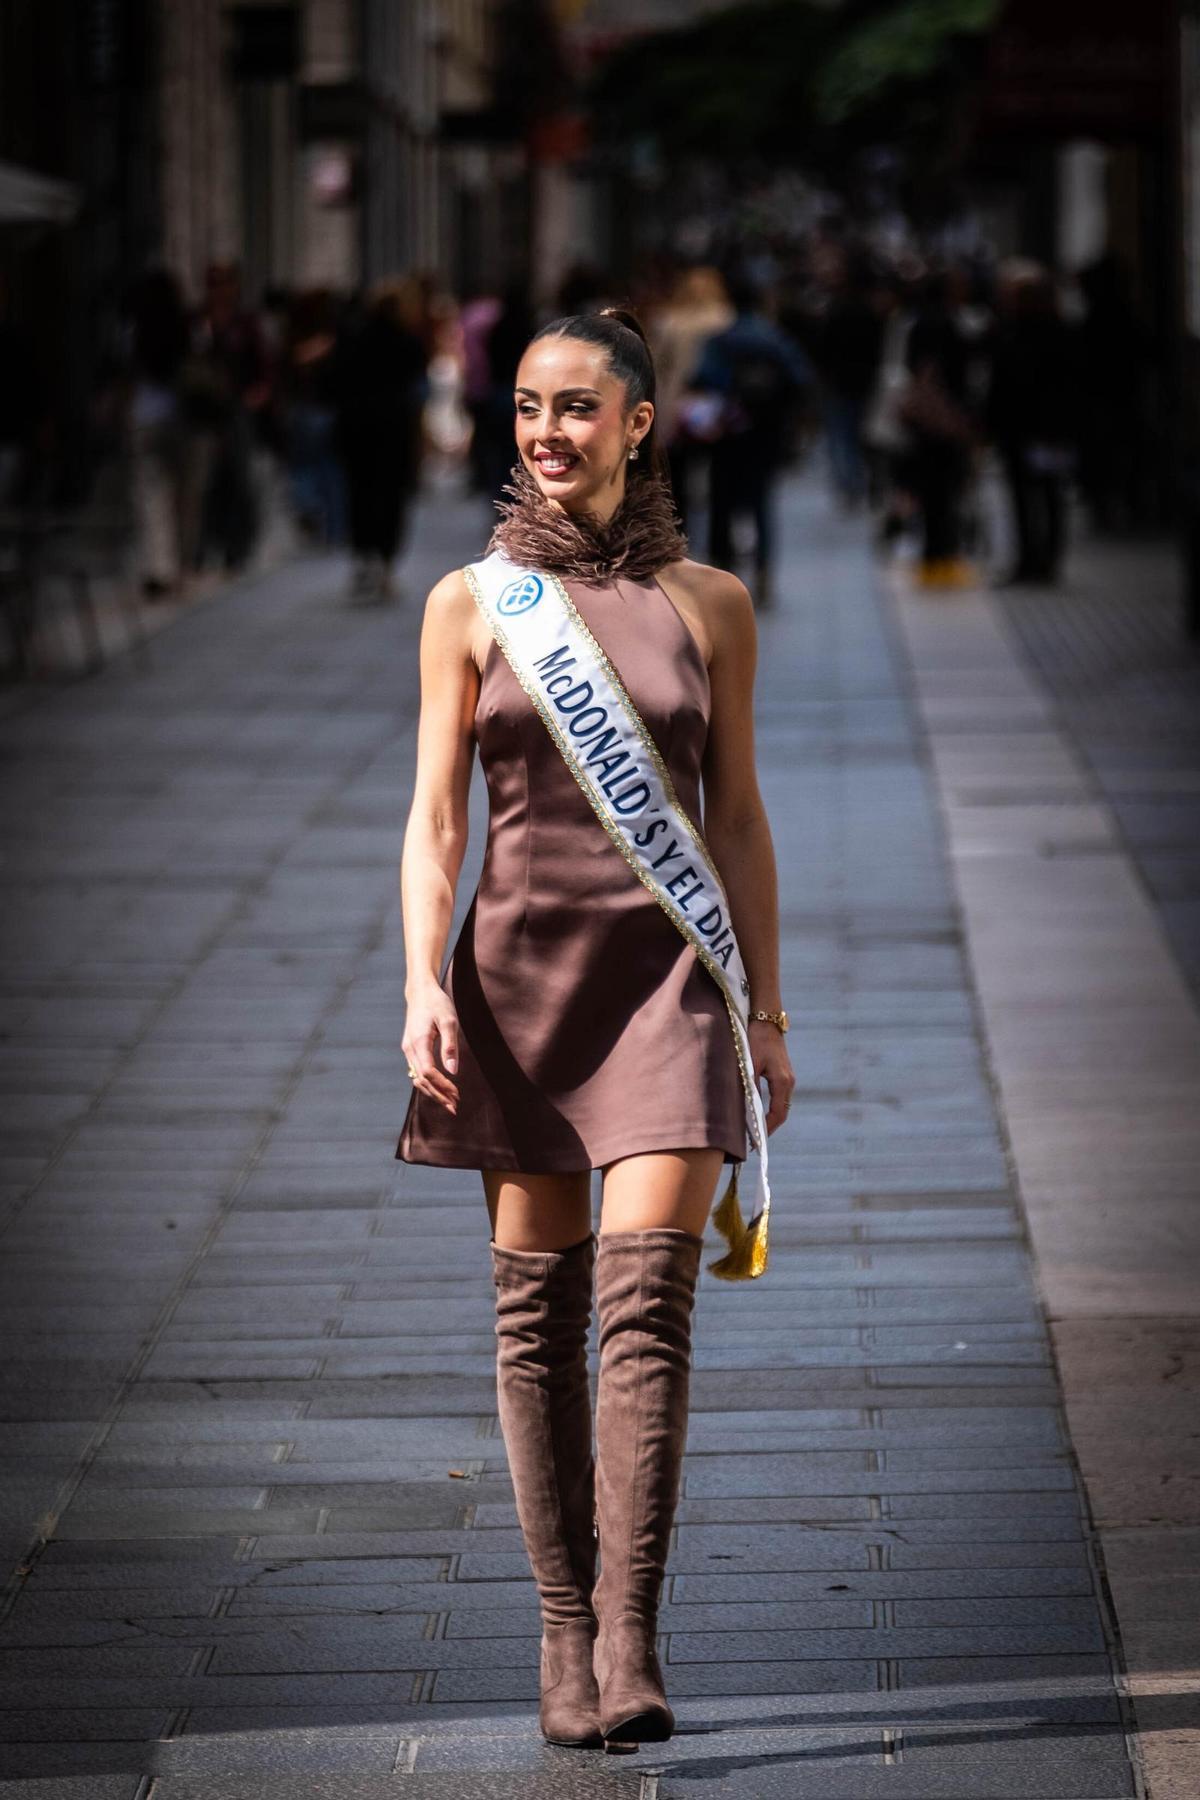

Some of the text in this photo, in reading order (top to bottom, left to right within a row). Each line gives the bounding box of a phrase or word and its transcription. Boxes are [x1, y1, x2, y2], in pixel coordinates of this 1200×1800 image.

[532, 644, 669, 847] McDONALD'S
[651, 839, 685, 870] Y
[664, 865, 705, 912] EL
